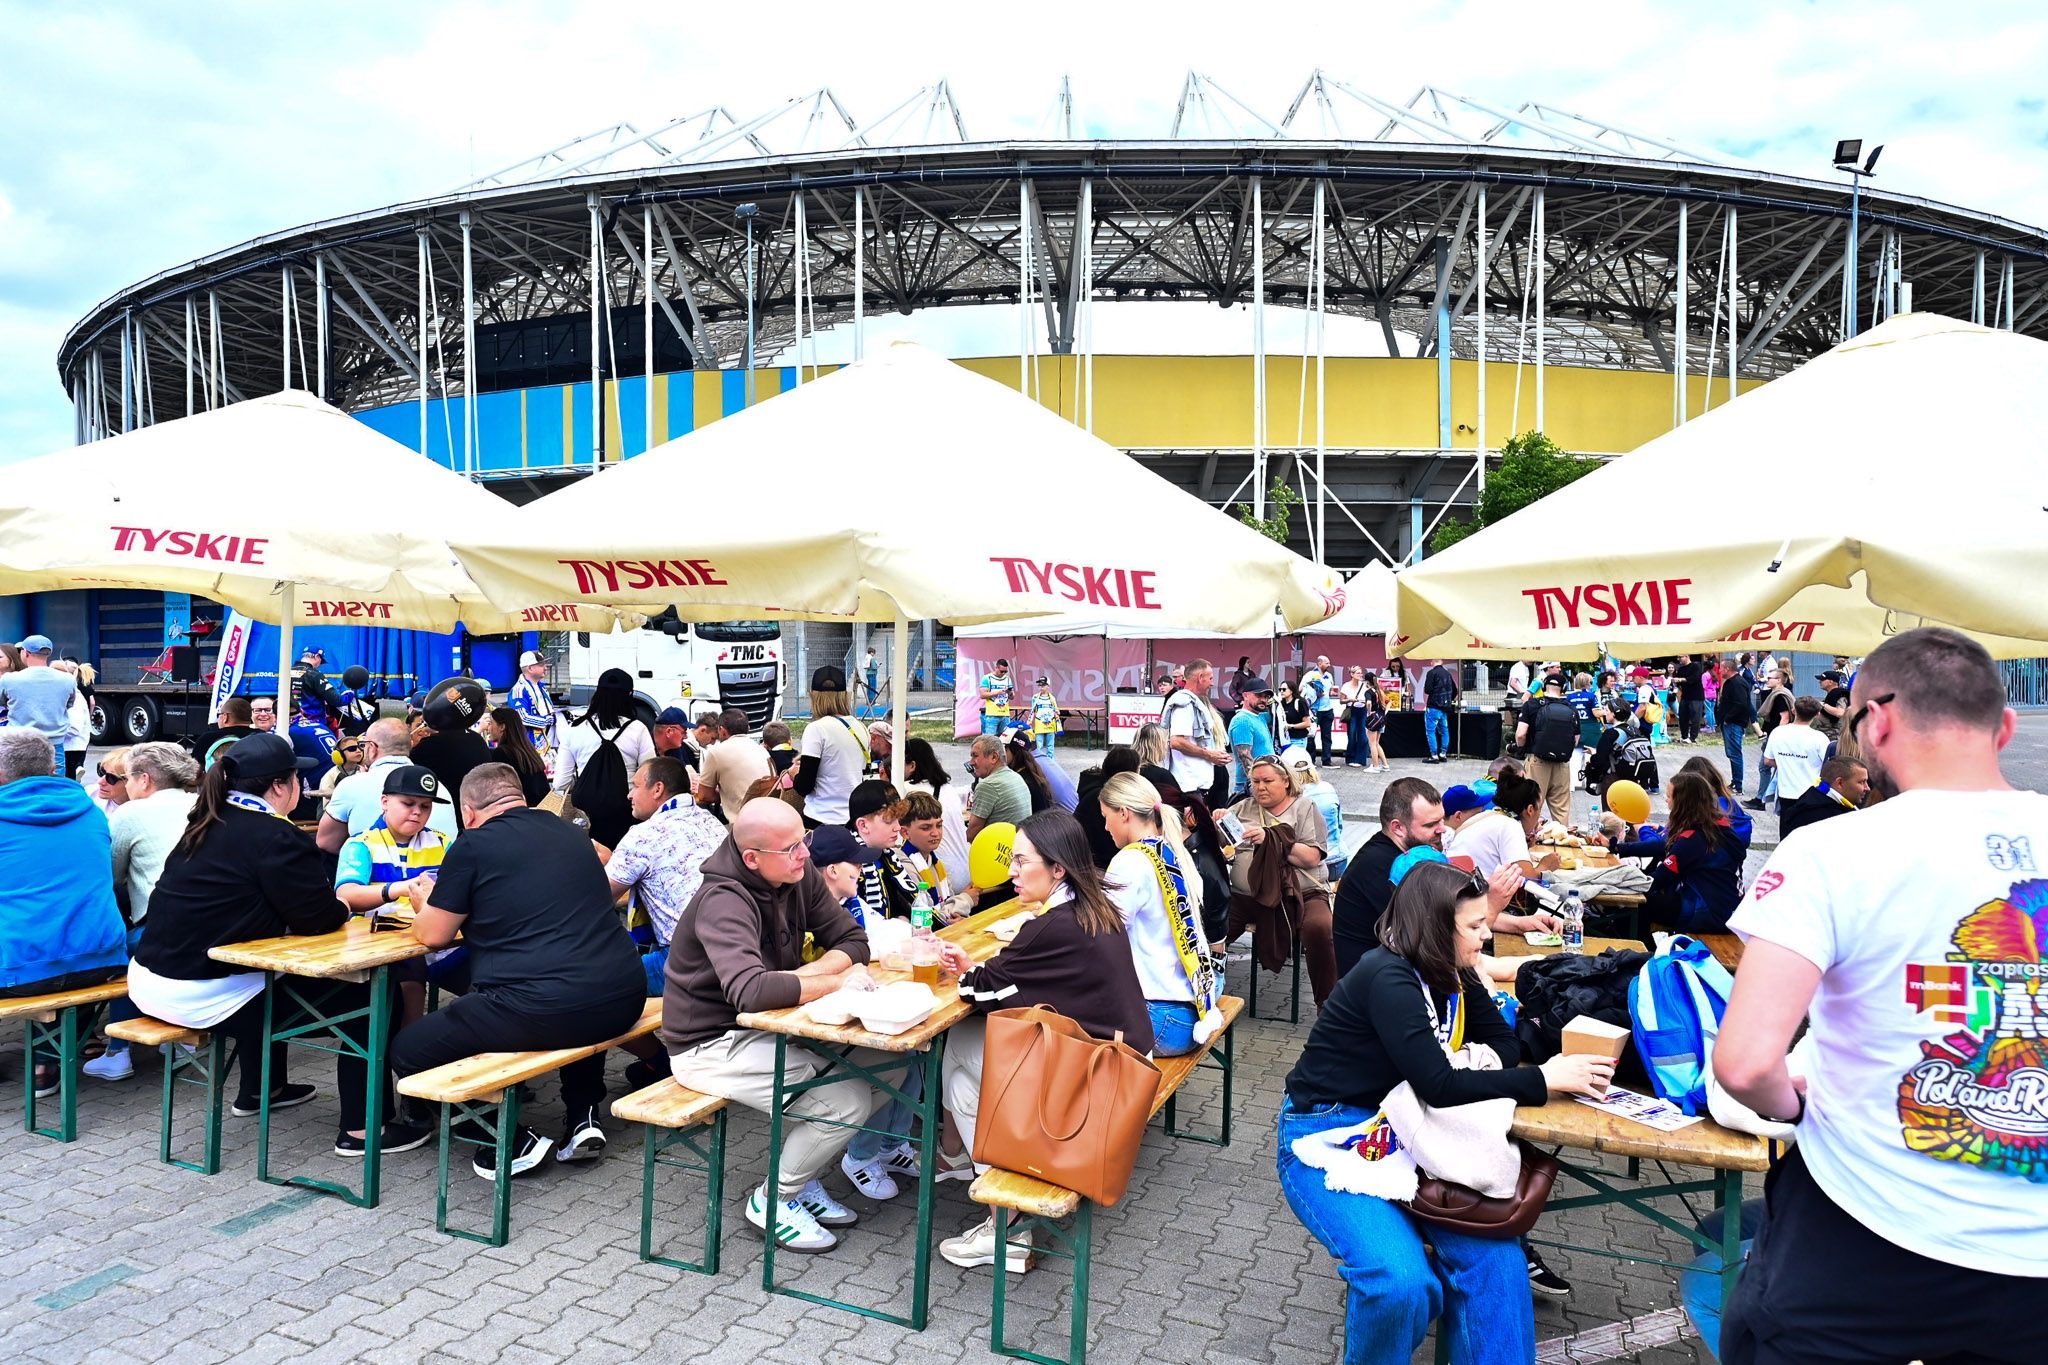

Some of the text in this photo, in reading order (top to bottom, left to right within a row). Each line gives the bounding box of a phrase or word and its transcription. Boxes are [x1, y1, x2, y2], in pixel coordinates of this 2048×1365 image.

[111, 526, 269, 565] TYSKIE
[558, 559, 728, 594] TYSKIE
[990, 557, 1162, 609] TYSKIE
[1522, 578, 1692, 629] TYSKIE
[227, 628, 242, 663] GRA
[731, 645, 764, 661] TMC
[1986, 834, 2037, 871] 31
[1909, 981, 1963, 992] mBank
